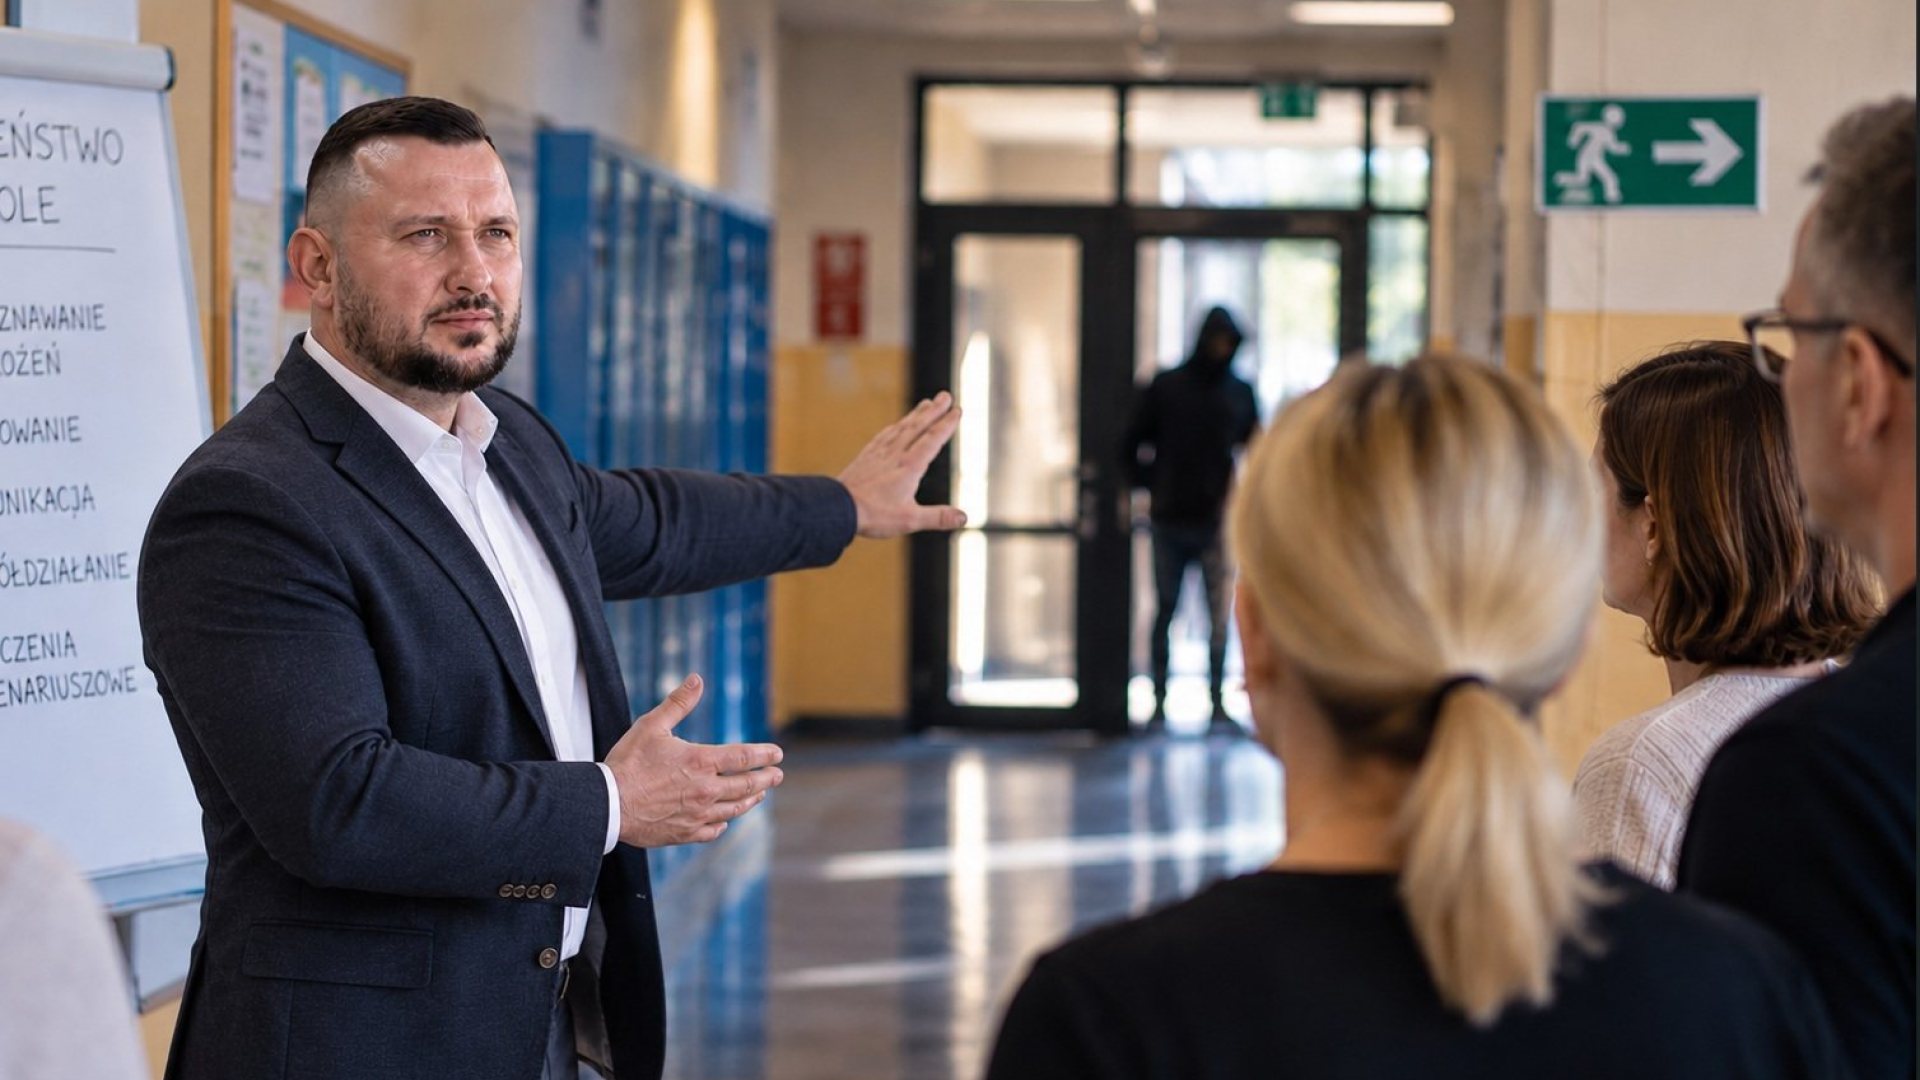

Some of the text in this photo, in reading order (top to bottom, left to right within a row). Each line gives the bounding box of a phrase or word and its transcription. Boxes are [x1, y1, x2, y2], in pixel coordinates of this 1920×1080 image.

[0, 110, 124, 165] ŃSTWO
[0, 185, 60, 224] OLE
[0, 303, 107, 332] ZNAWANIE
[0, 415, 82, 445] OWANIE
[0, 552, 130, 589] ÓŁDZIAŁANIE
[0, 630, 77, 664] CZENIA
